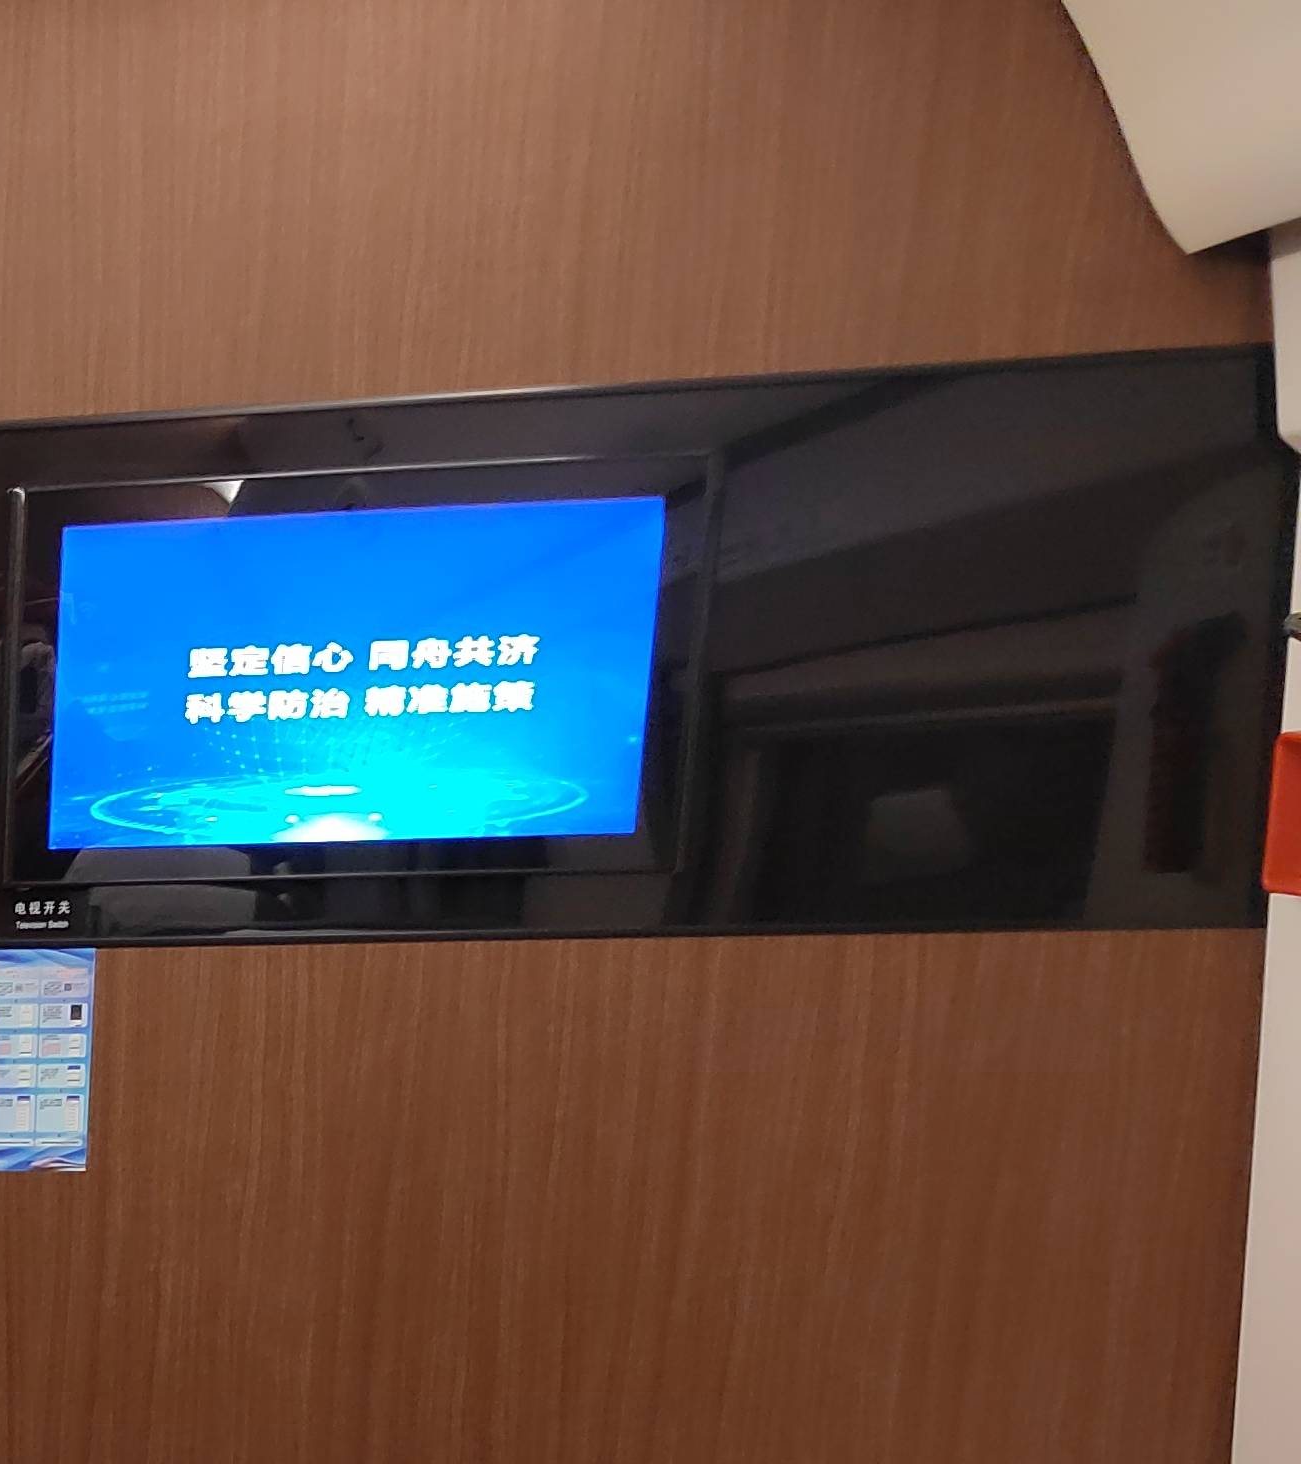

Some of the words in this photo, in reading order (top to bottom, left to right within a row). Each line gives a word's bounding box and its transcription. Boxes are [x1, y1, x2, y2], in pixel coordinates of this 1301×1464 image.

[187, 641, 354, 679] 坚定信心
[368, 633, 540, 671] 同舟共济
[184, 688, 351, 725] 科学防治
[364, 680, 535, 717] 精准施策
[14, 900, 71, 915] 电视开关
